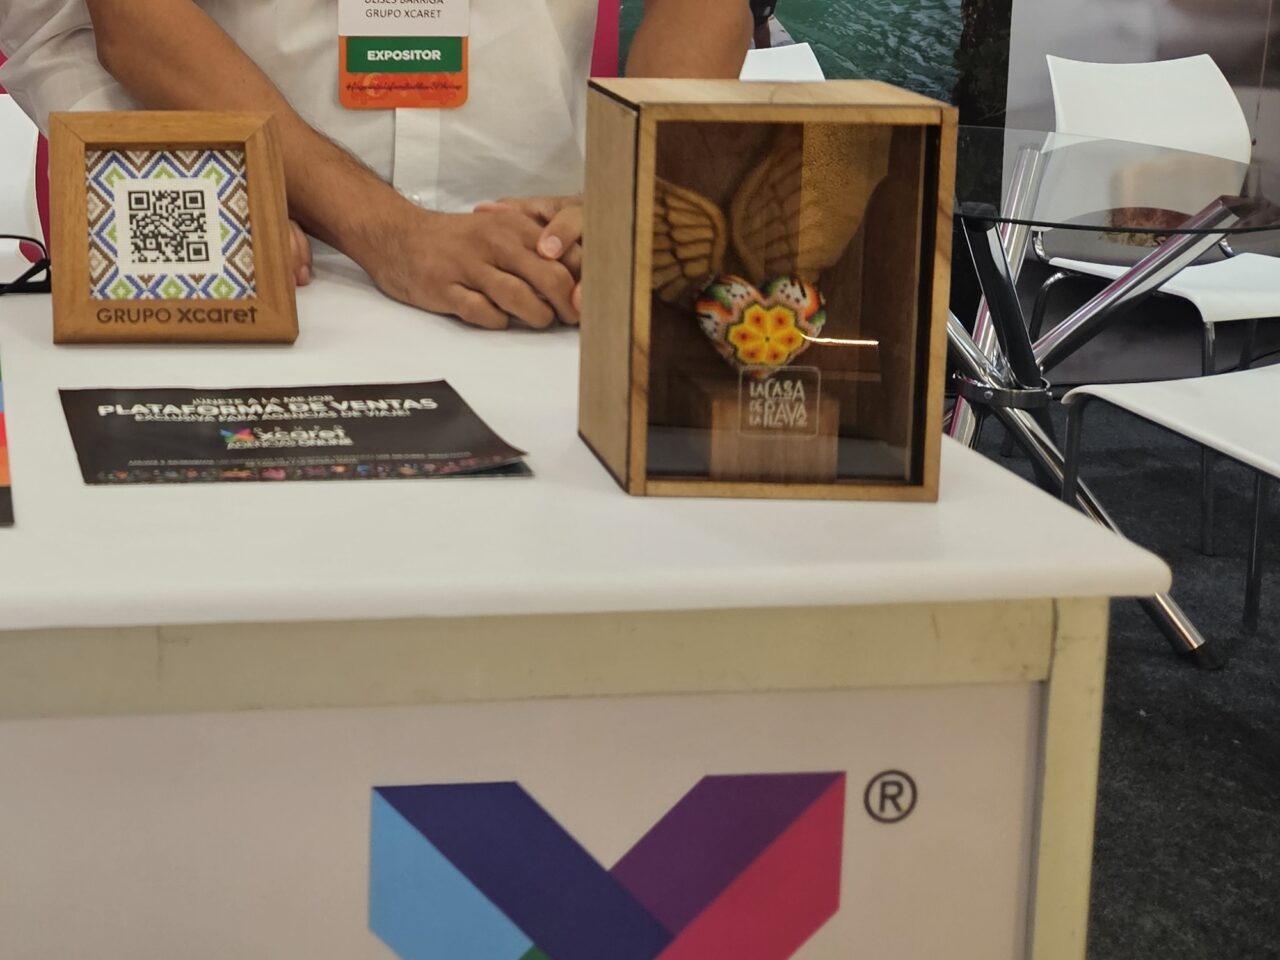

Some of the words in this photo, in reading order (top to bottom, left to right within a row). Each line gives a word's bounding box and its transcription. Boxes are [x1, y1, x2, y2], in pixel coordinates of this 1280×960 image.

[365, 8, 402, 19] GRUPO
[403, 9, 442, 19] XCARET
[366, 49, 442, 62] EXPOSITOR
[96, 306, 172, 325] GRUPO
[177, 304, 258, 325] xcaret
[97, 403, 285, 417] PLATAFORMA
[287, 401, 328, 411] DE
[329, 397, 439, 410] VENTAS
